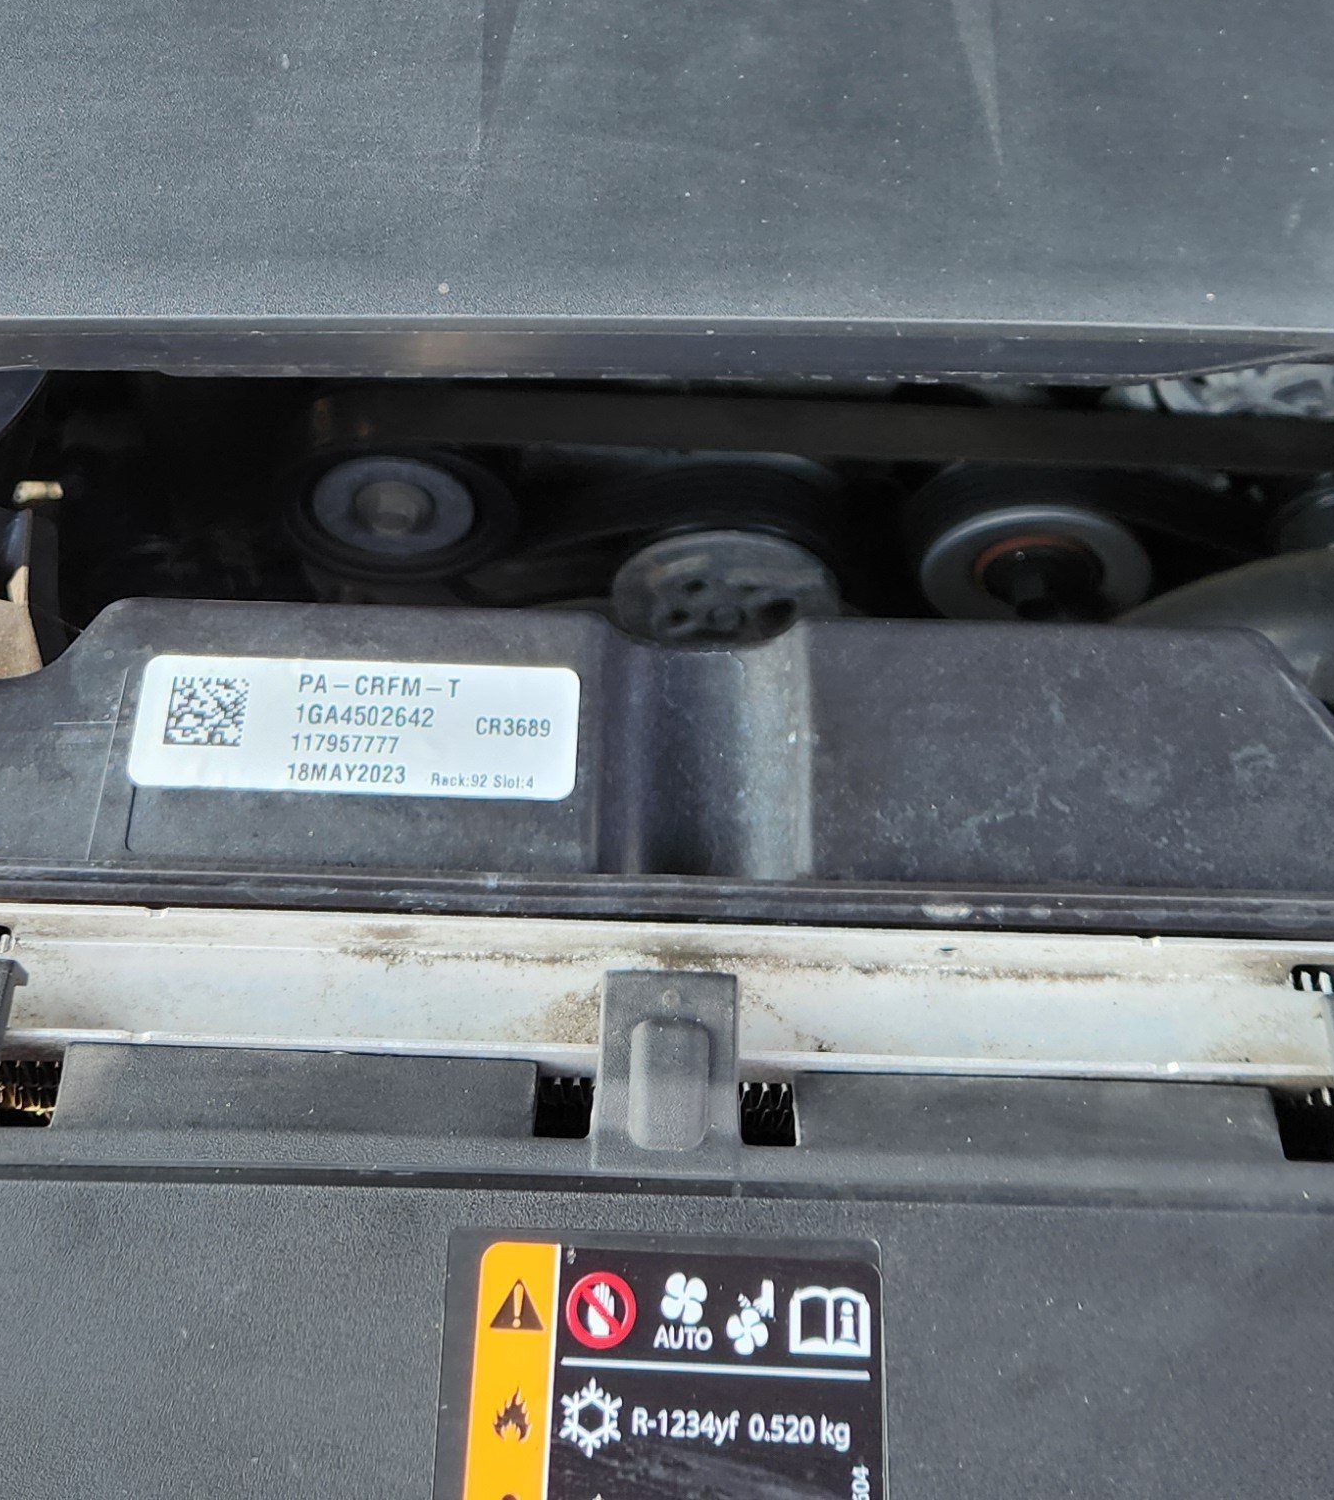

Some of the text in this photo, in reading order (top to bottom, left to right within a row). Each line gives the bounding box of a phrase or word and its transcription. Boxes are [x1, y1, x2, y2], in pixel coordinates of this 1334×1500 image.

[296, 703, 435, 728] 1GA4502642
[475, 717, 552, 738] CR3689
[290, 731, 400, 755] 117957777
[287, 762, 407, 785] 18MAY2023
[653, 1325, 714, 1351] AUTO
[631, 1405, 851, 1452] R-1234yf 0.520 kg
